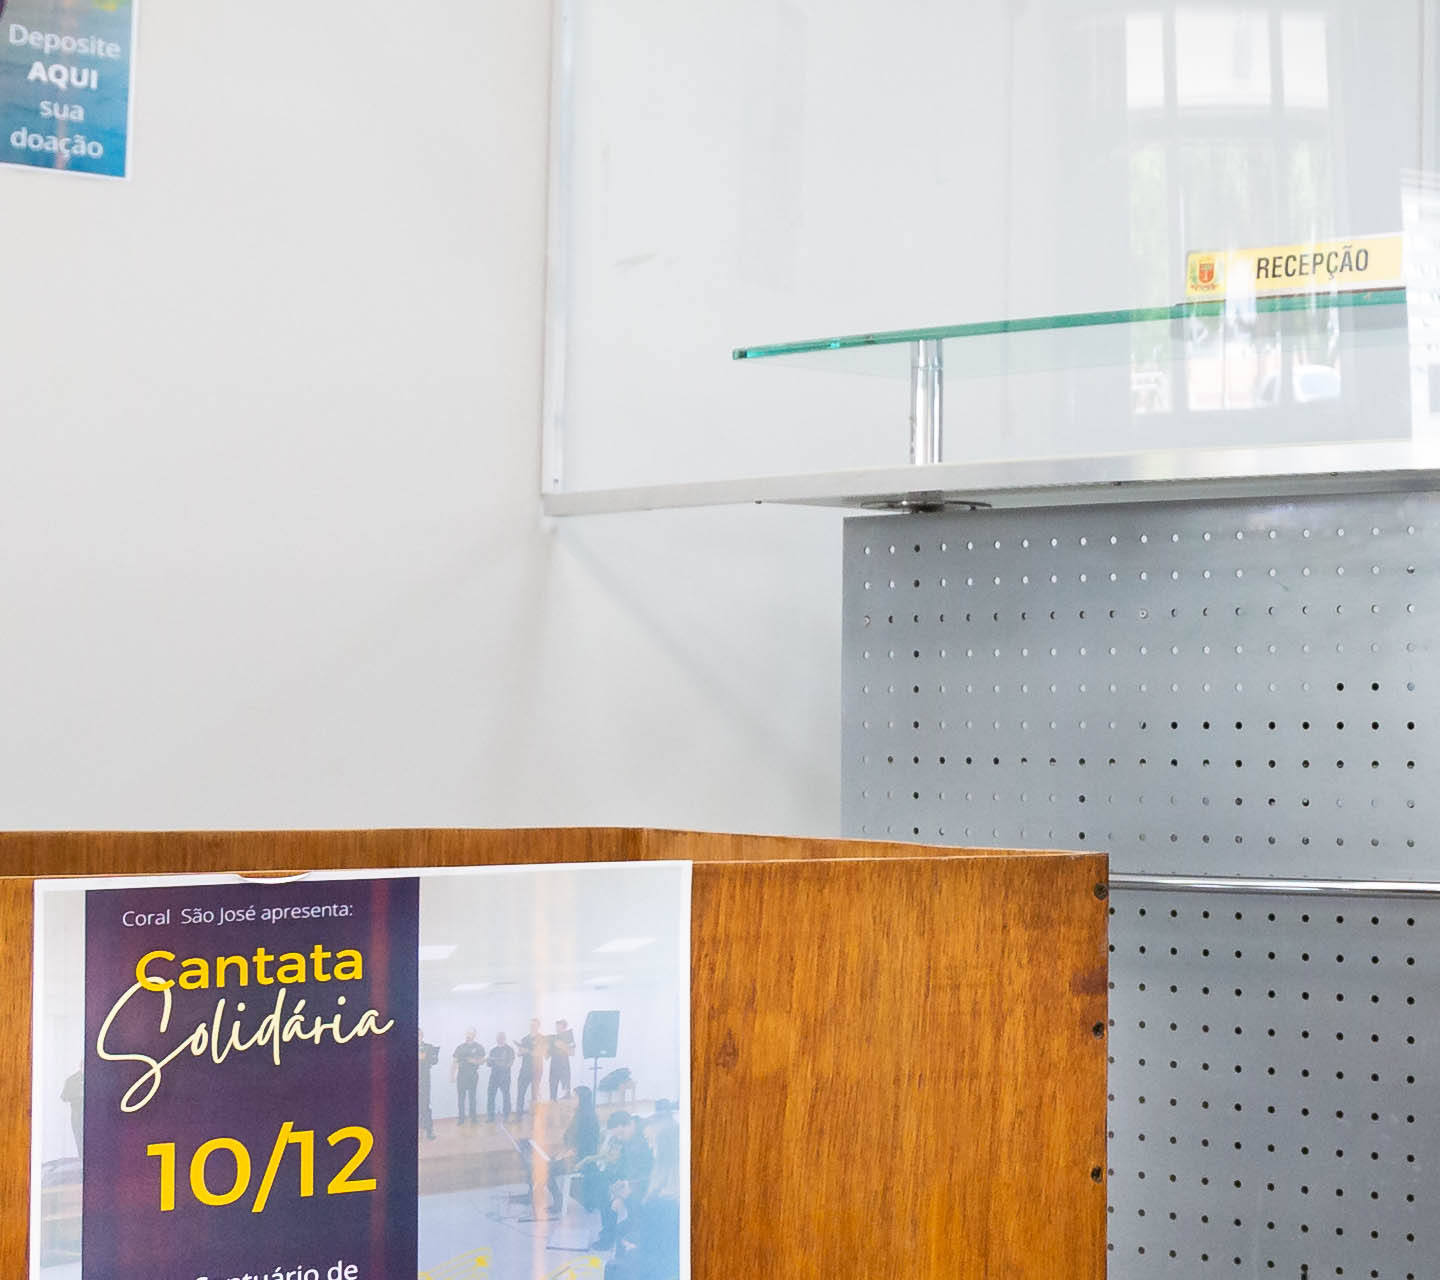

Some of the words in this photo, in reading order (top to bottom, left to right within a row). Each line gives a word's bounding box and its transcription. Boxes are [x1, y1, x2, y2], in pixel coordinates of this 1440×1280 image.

[8, 23, 122, 60] Deposite
[27, 60, 98, 90] AQUI
[39, 97, 85, 122] sua
[10, 128, 104, 160] doação
[1256, 244, 1369, 280] RECEPÇÃO
[122, 907, 171, 928] Coral
[180, 906, 214, 925] São
[217, 903, 256, 925] José
[260, 901, 354, 925] apresenta:
[135, 943, 365, 993] Cantata
[96, 975, 394, 1113] Solidária
[146, 1121, 377, 1213] 10/12
